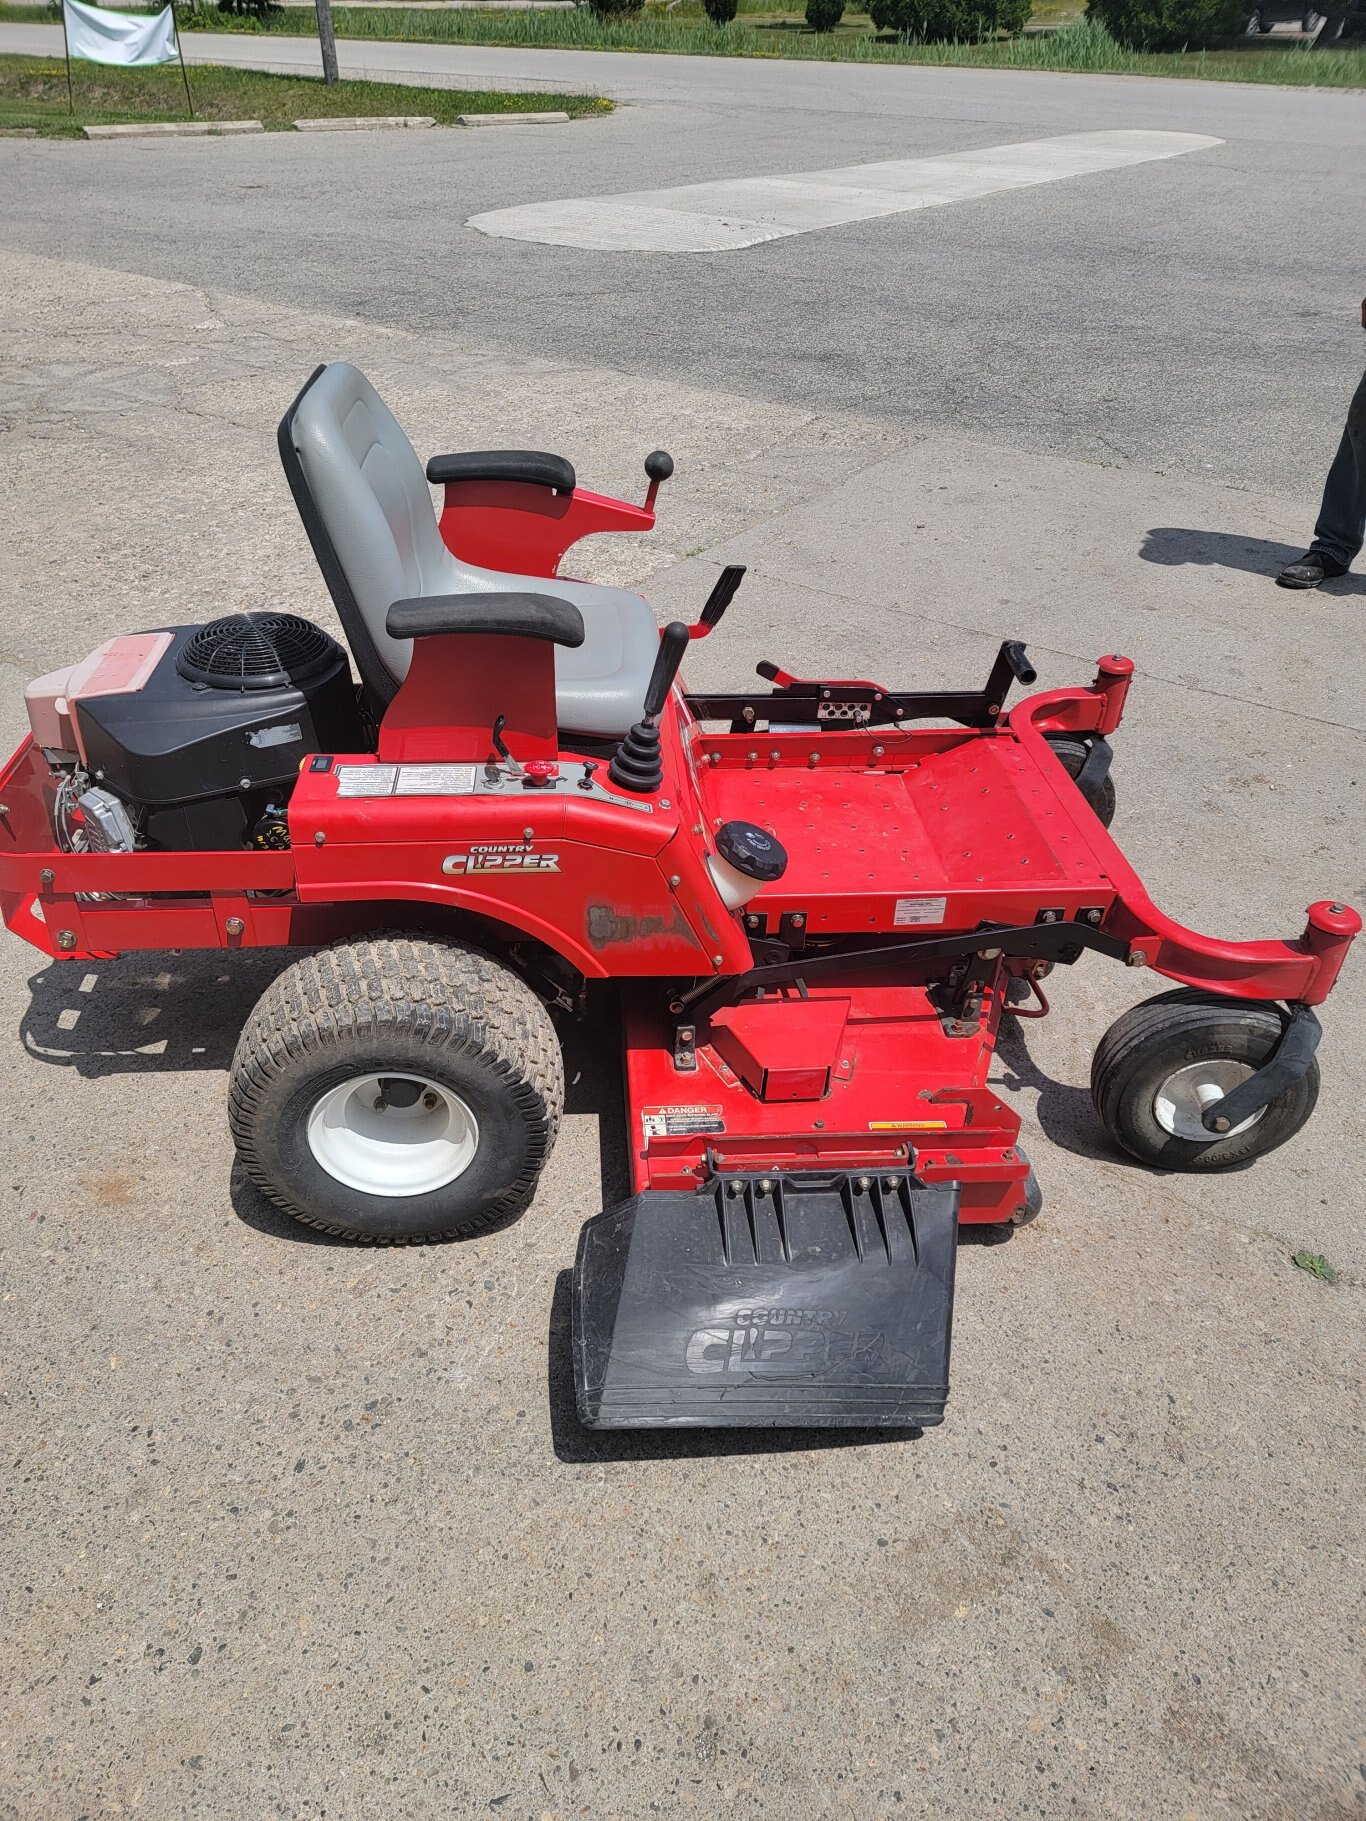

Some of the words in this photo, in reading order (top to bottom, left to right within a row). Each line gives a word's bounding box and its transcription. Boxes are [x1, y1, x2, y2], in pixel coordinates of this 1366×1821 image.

[469, 844, 534, 854] COUNTRY
[441, 853, 563, 875] CLIPPER
[667, 1106, 707, 1114] DANGER
[735, 1307, 848, 1327] COUNTRY
[685, 1326, 891, 1375] CLIPPER
